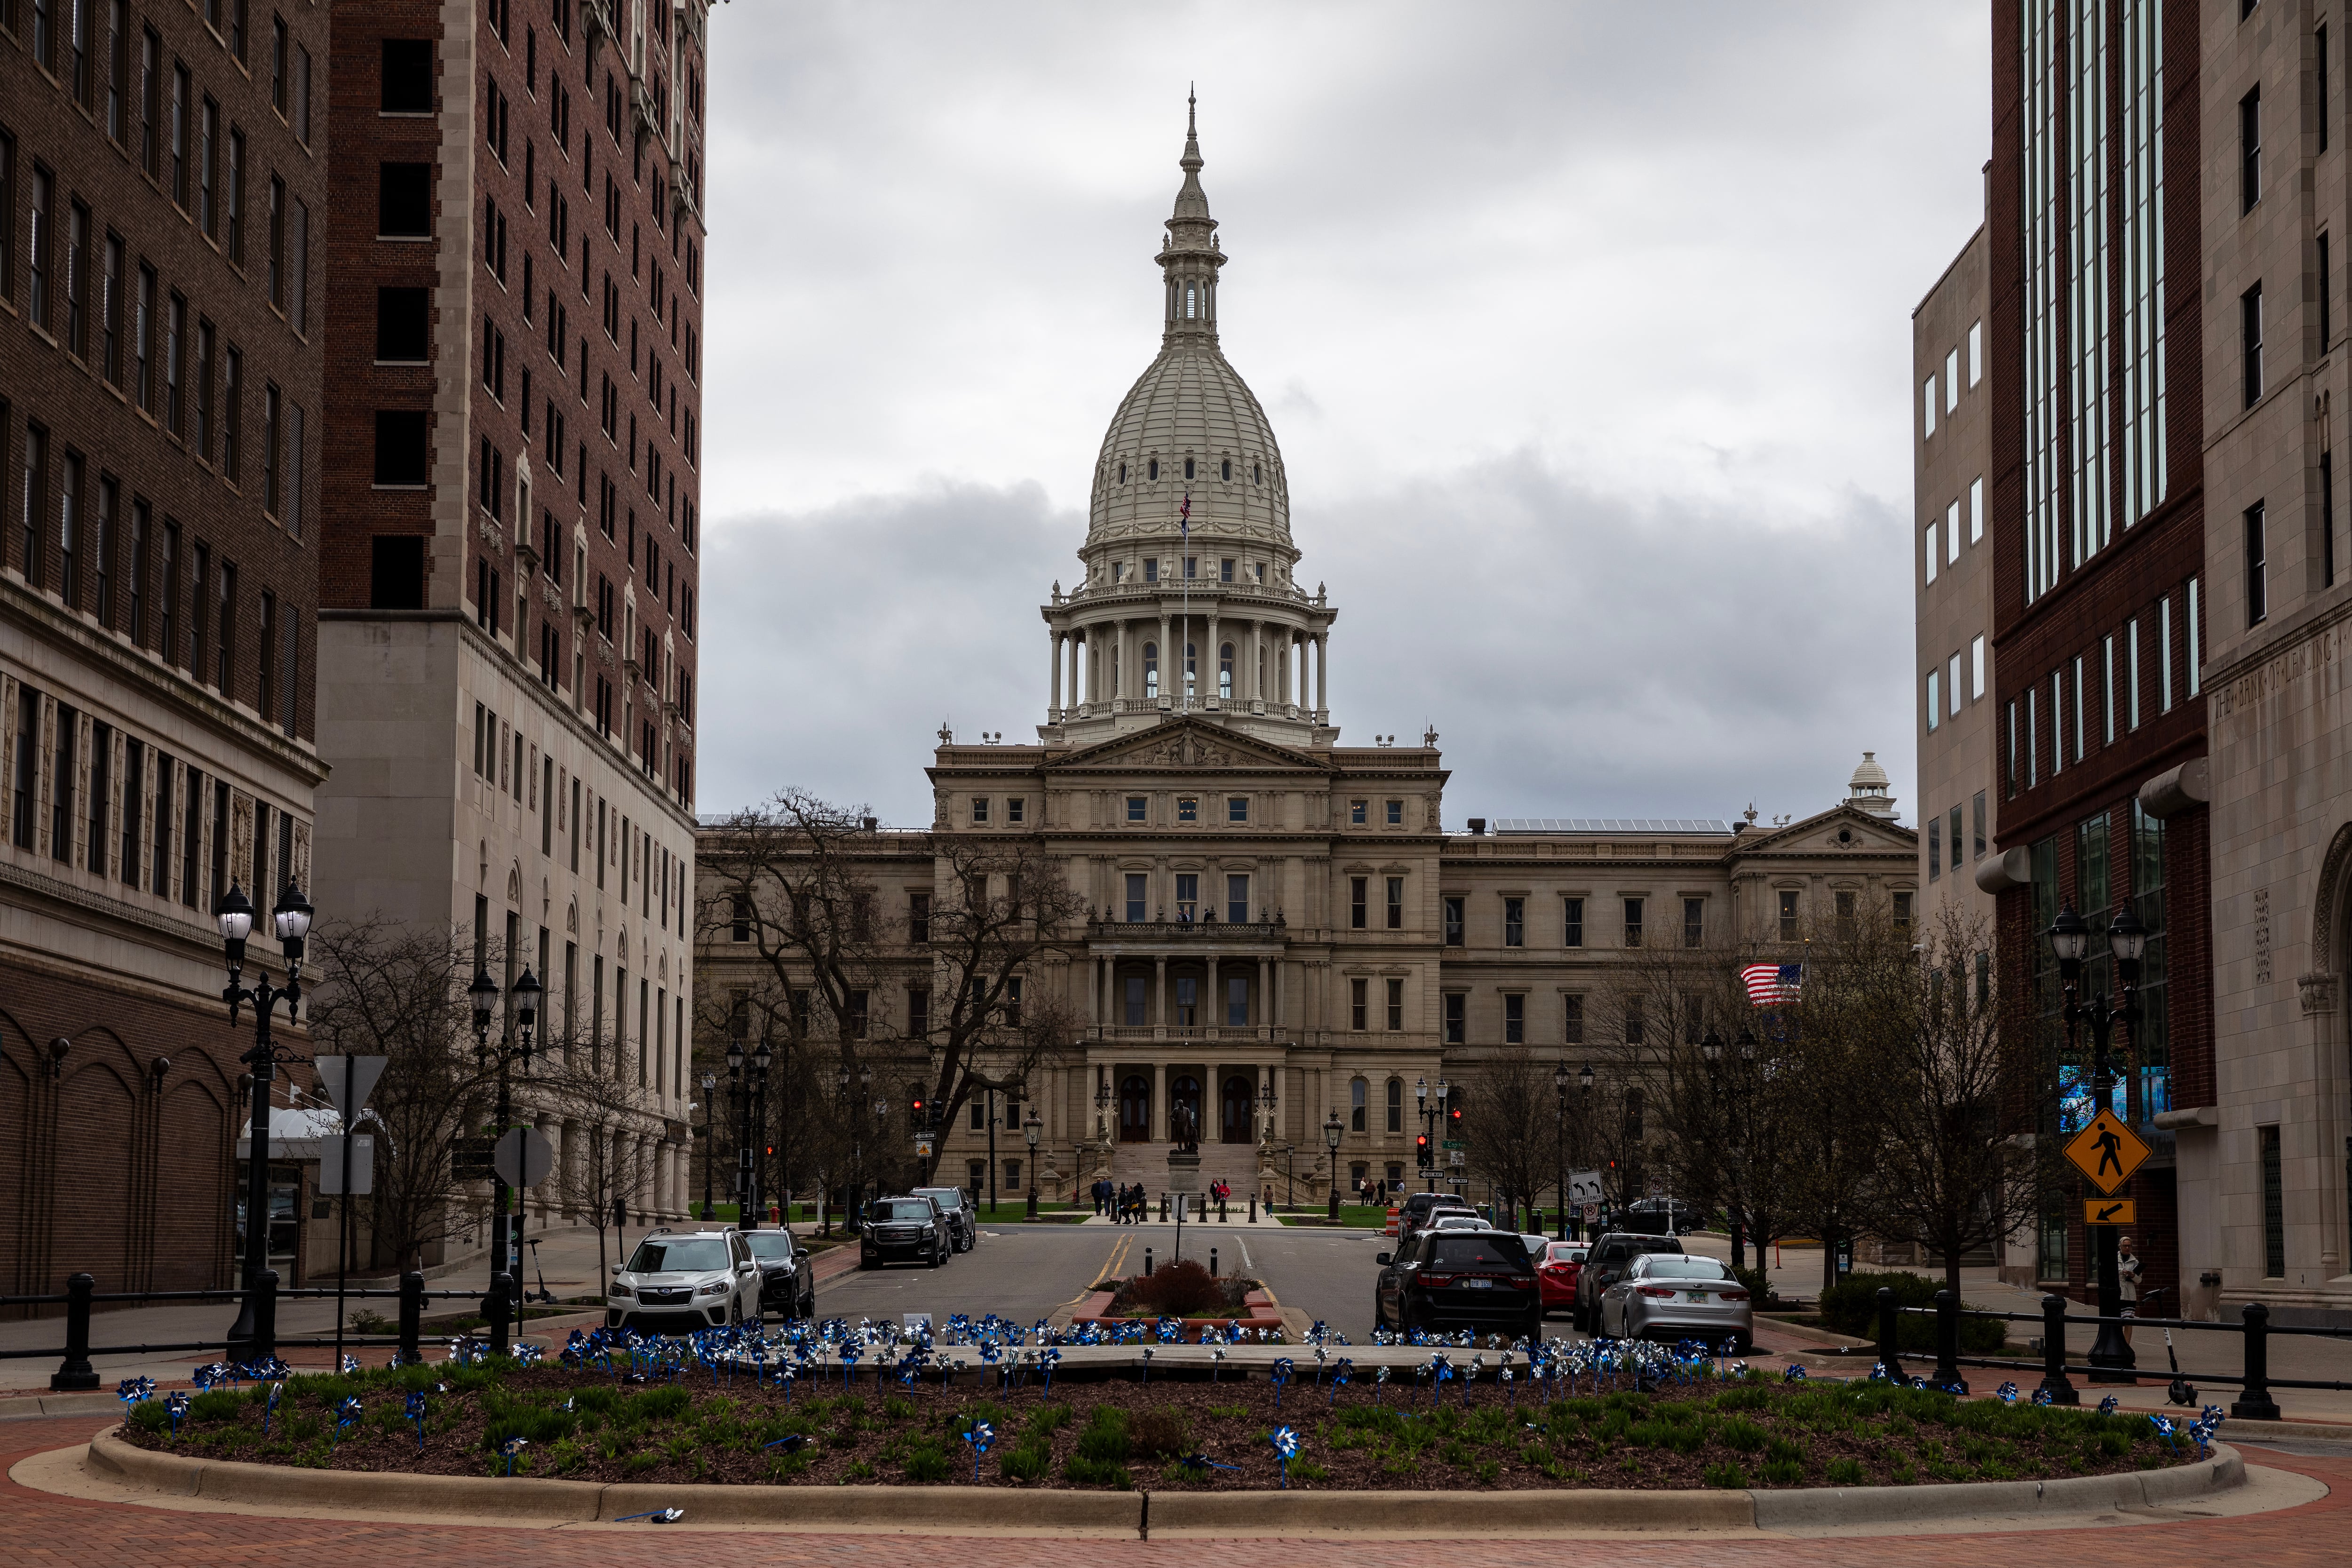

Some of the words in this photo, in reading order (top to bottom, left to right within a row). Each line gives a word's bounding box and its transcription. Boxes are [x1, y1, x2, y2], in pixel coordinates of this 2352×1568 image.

[2215, 688, 2231, 720] THE
[2239, 670, 2265, 707] BANK
[2269, 661, 2280, 691] OF
[2285, 633, 2332, 683] LANSING
